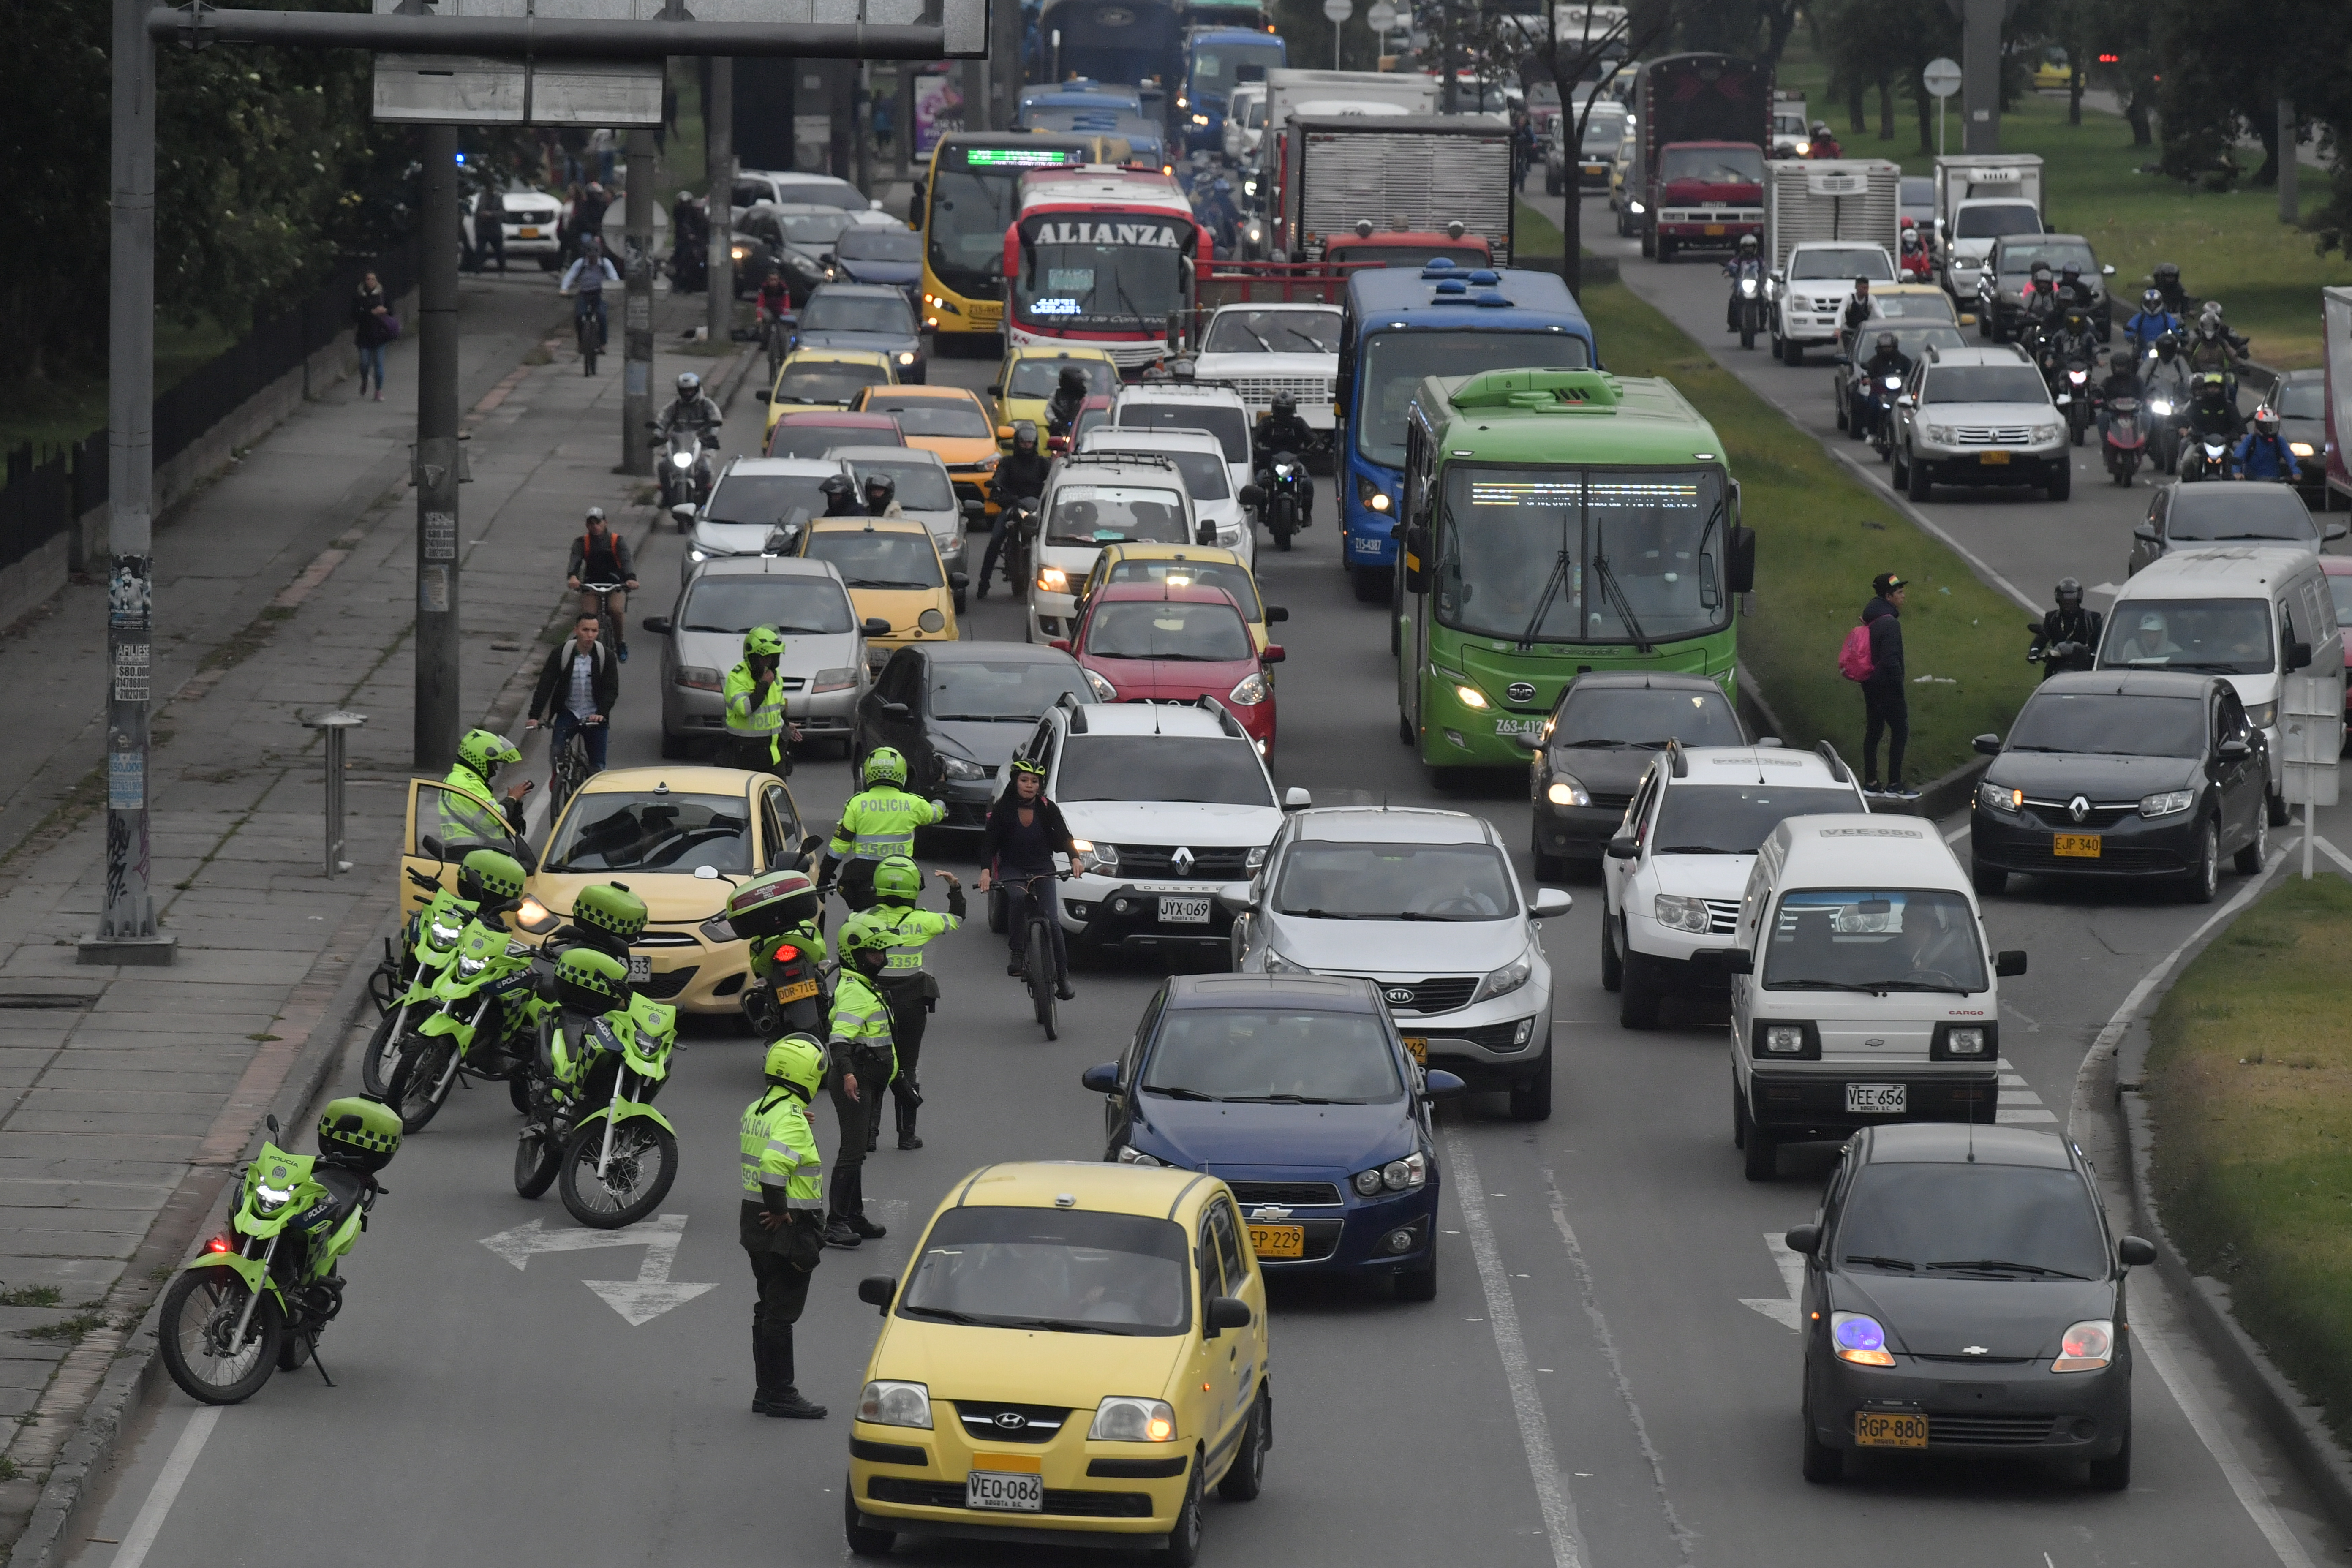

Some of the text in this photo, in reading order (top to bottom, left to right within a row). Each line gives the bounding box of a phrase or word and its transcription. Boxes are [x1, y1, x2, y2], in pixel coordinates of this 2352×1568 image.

[1034, 223, 1179, 248] ALIANZA
[1509, 688, 1533, 697] BYD
[1496, 719, 1544, 732] Z63-412
[861, 799, 910, 812] POLICIA
[860, 844, 905, 855] 95019
[2056, 838, 2099, 851] EJP 340
[1390, 992, 1409, 1000] KIA
[269, 1155, 298, 1168] POLICÍA
[1251, 1231, 1300, 1248] EP 229
